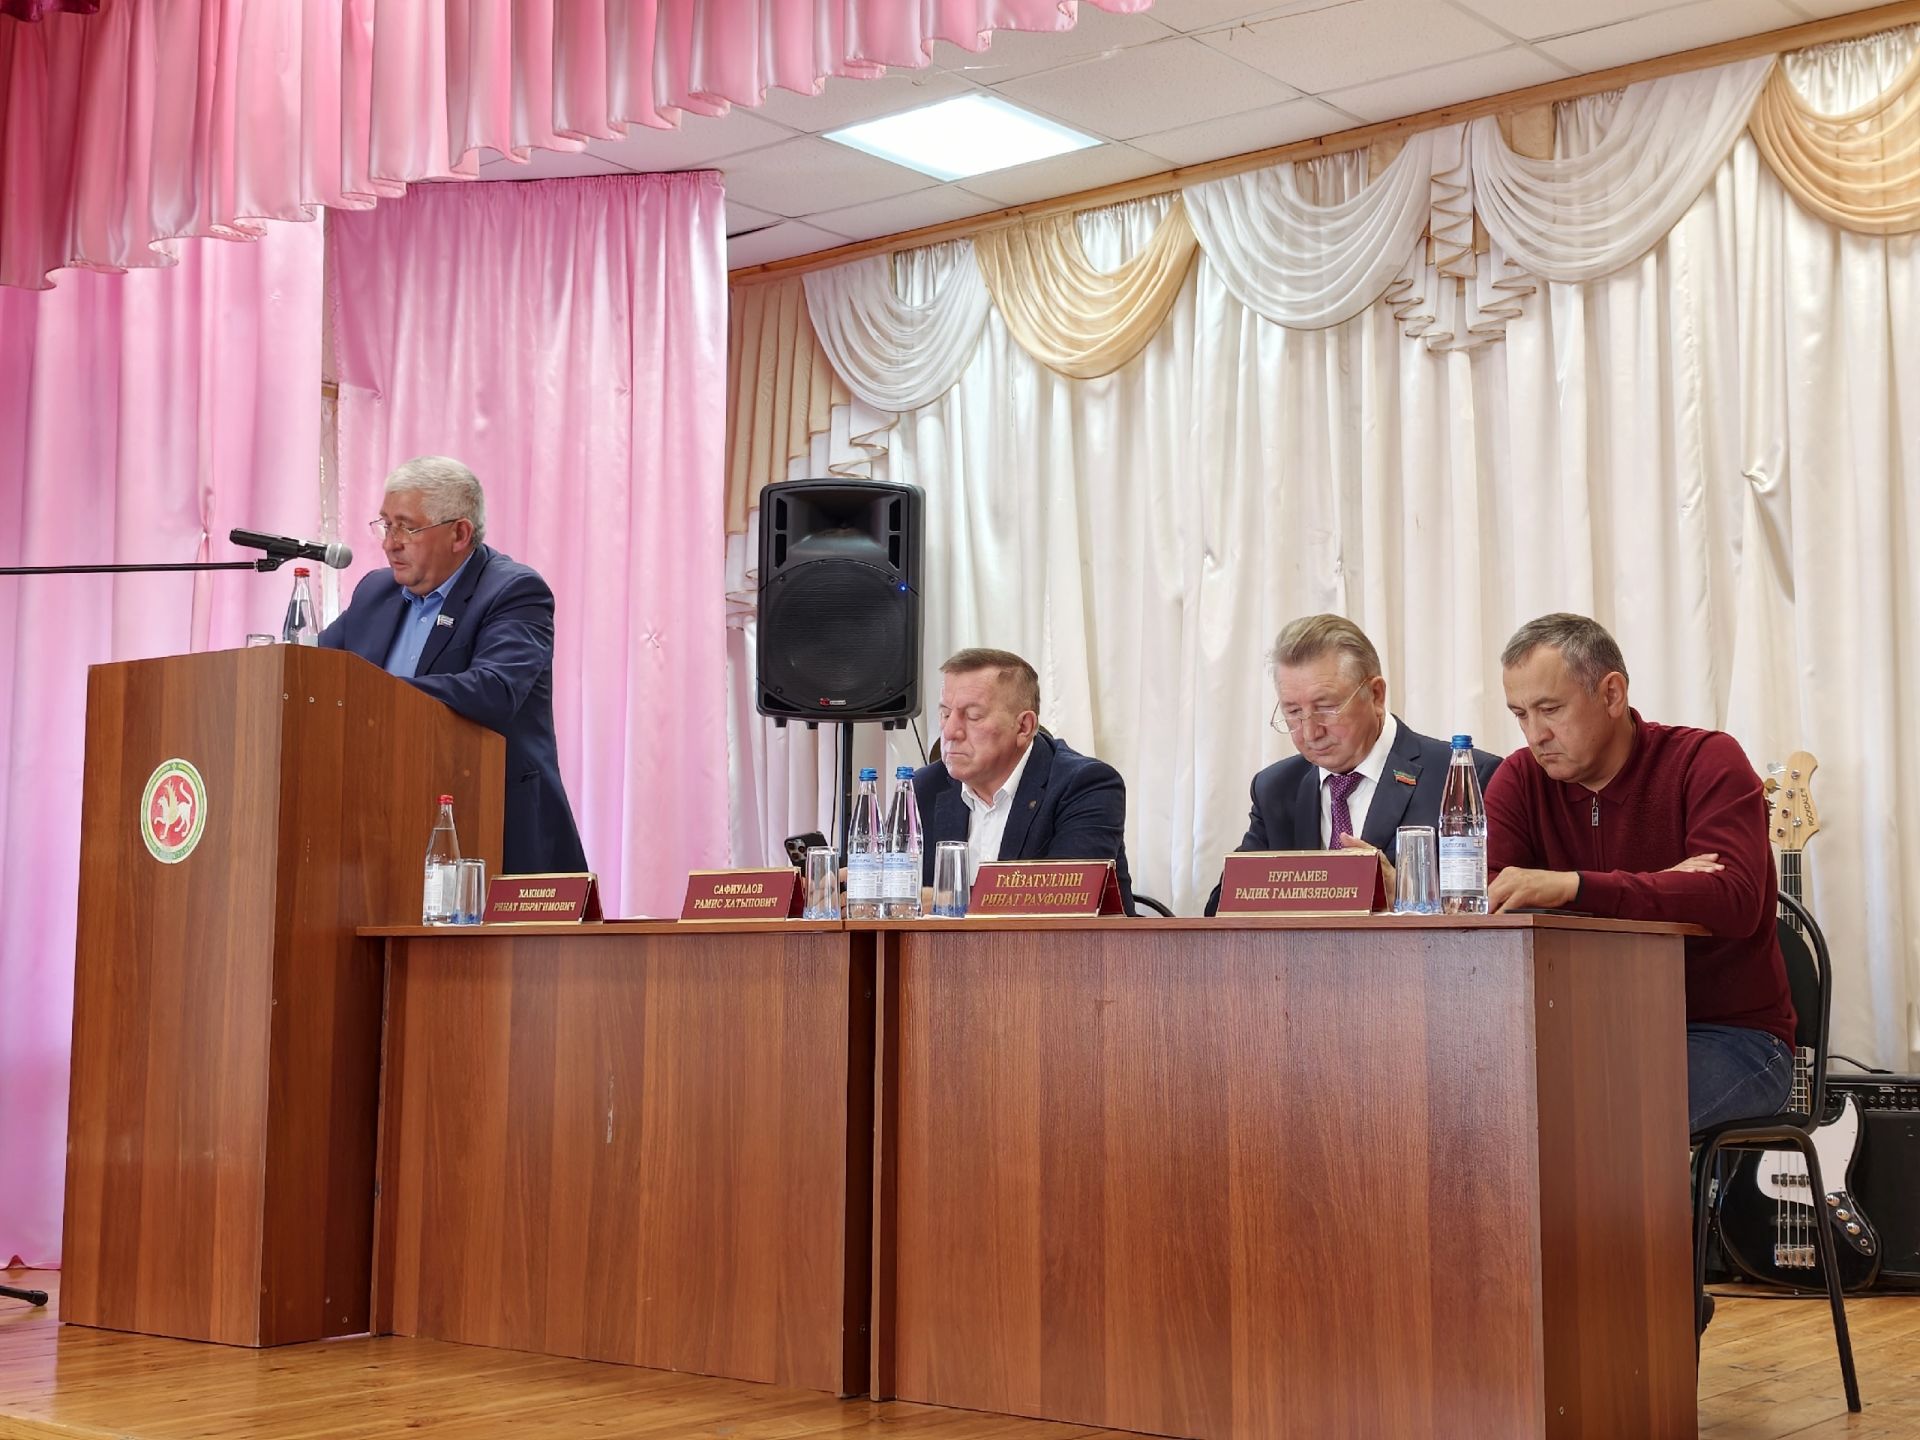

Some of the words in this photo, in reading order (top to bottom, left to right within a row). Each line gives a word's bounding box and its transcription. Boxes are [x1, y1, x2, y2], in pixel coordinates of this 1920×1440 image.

[995, 869, 1084, 888] ГАЙЗАТУЛЛИН
[1267, 870, 1329, 883] НУРГАЛИЕВ
[518, 888, 557, 898] ХАКИМОВ
[713, 883, 763, 895] САФИУЛЛОВ
[1235, 887, 1270, 901] РАДИК
[1271, 887, 1359, 900] ГАЛИМЗЯНОВИЧ
[694, 899, 723, 909] РАМИС
[724, 897, 778, 908] ХАТЫПОВИЧ
[980, 893, 1023, 906] РИНАТ
[1024, 892, 1090, 906] РАУФОВИЧ
[493, 902, 519, 912] РИНАТ
[519, 901, 577, 912] ИБРАГИМОВИЧ
